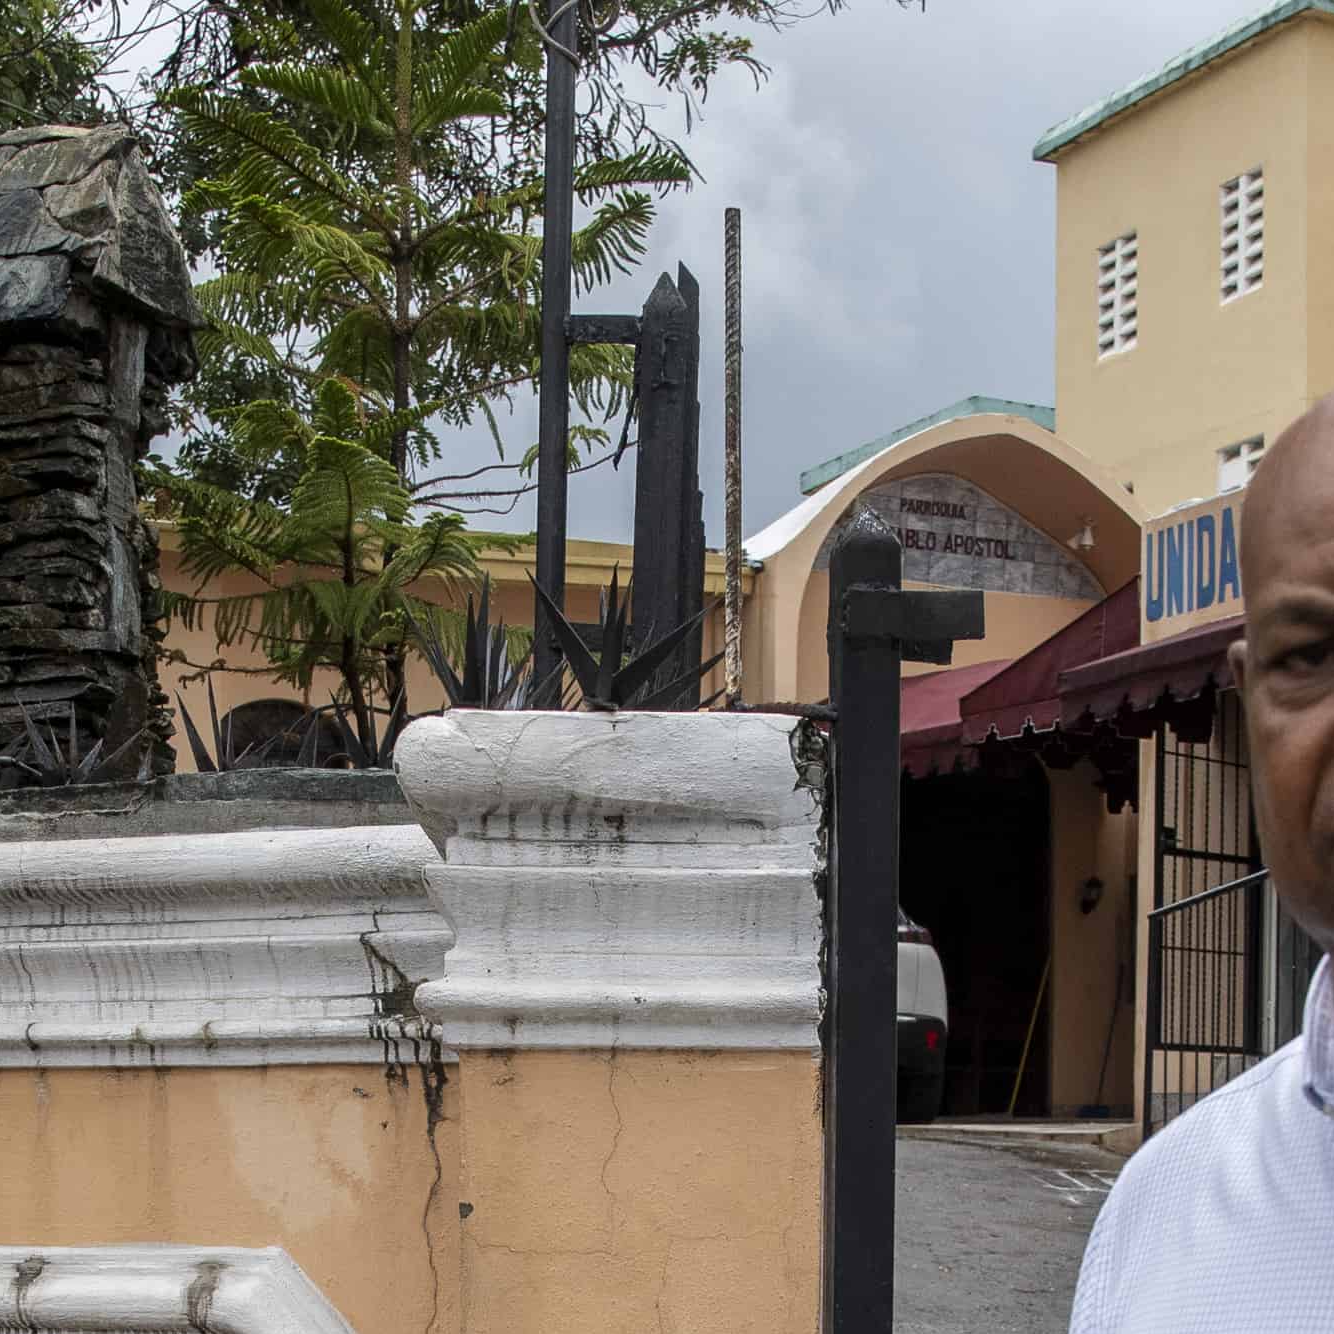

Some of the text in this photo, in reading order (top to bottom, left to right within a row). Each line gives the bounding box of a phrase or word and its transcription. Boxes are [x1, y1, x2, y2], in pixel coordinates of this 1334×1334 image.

[900, 498, 967, 520] PARROQUIA
[943, 534, 1016, 560] APOSTOL
[1146, 505, 1242, 622] UNIDA
